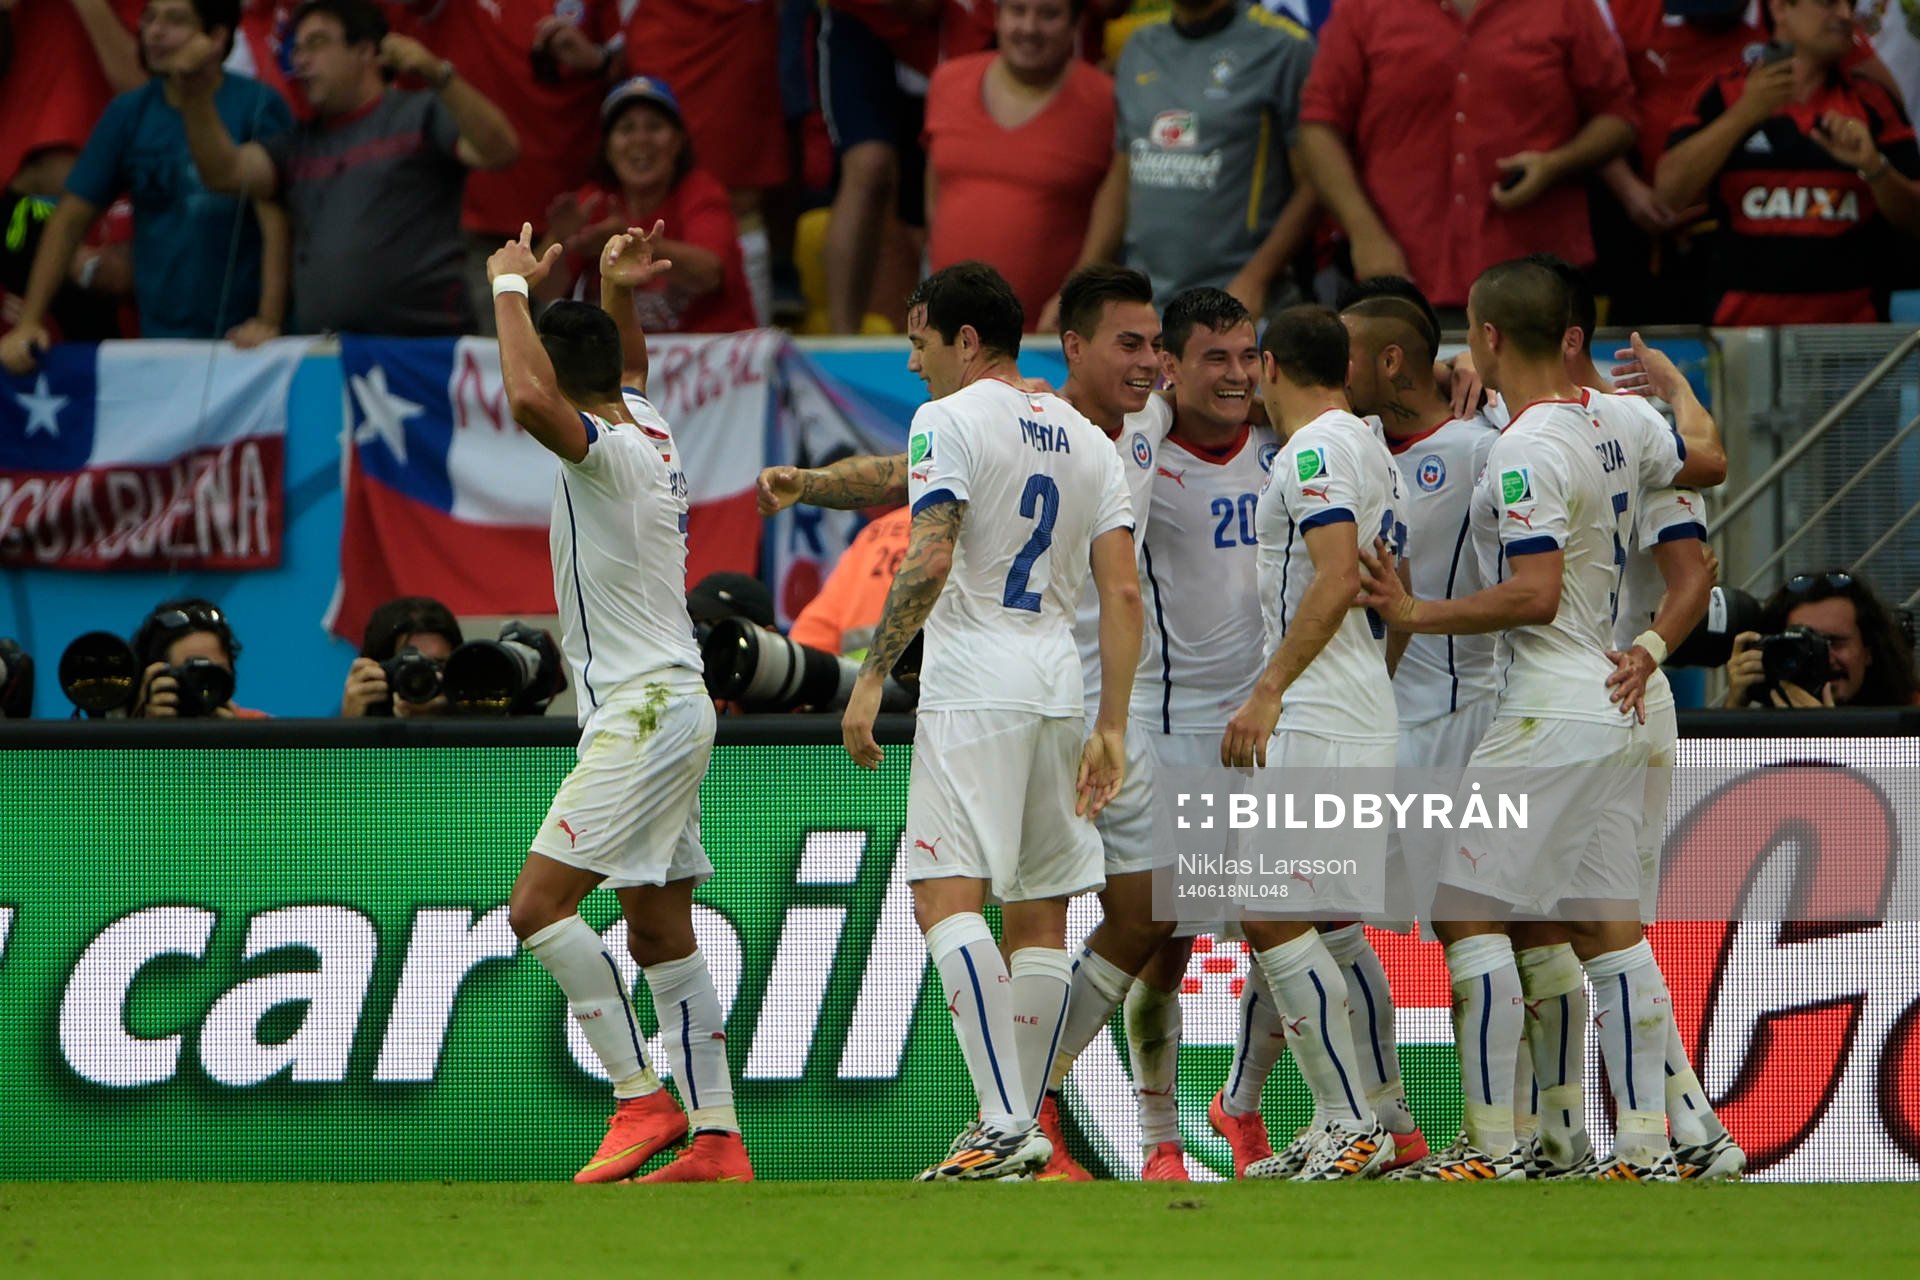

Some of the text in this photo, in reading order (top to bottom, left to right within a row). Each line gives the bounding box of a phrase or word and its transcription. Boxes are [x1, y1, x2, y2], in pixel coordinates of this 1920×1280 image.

[1742, 186, 1859, 220] CAIXA
[1003, 474, 1060, 613] 2
[1211, 492, 1258, 549] 20
[58, 903, 518, 1088] car
